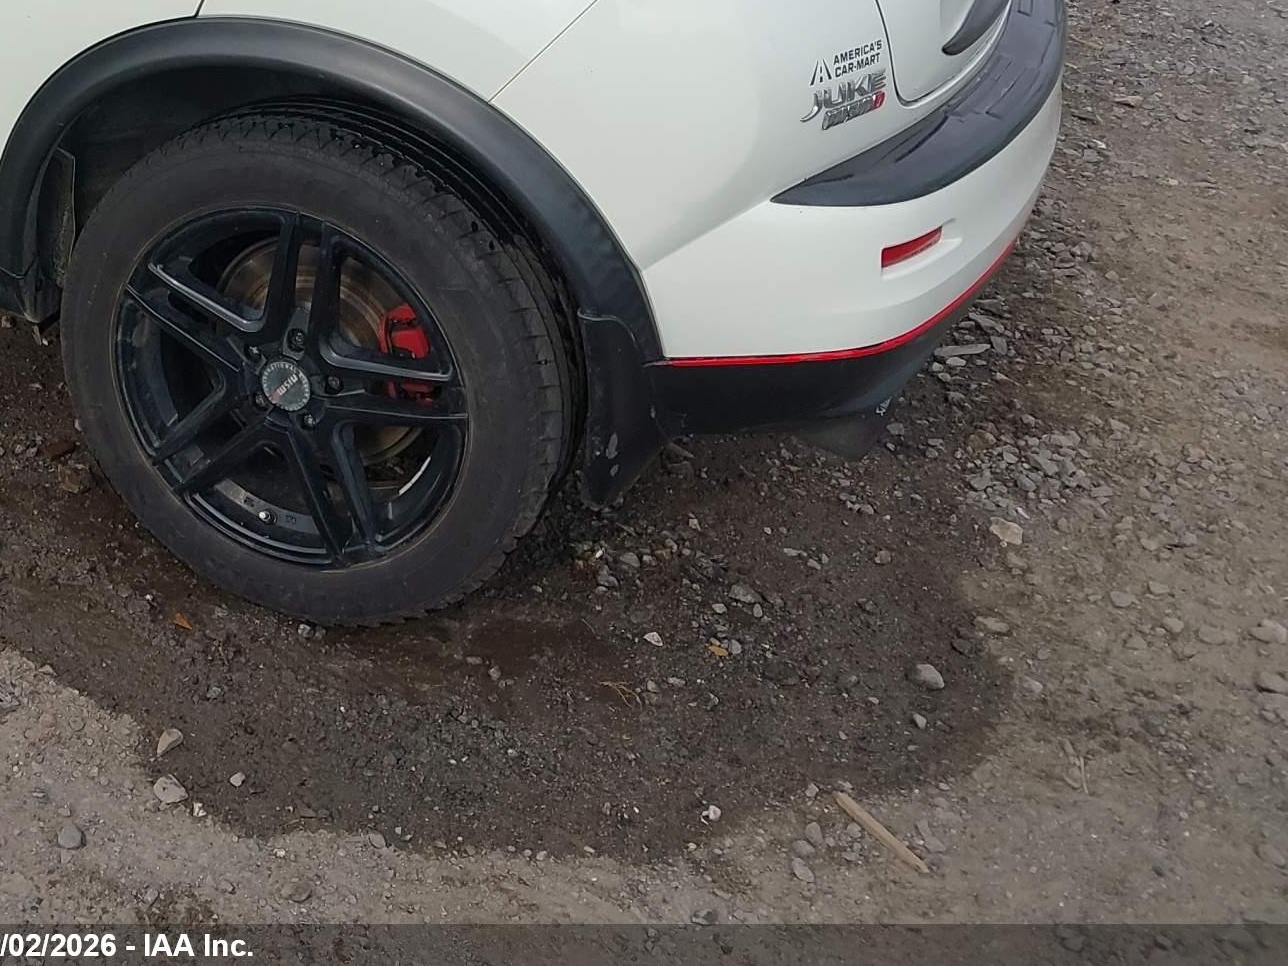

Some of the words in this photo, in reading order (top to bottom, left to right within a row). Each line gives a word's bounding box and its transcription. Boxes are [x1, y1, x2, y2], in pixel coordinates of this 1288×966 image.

[833, 39, 883, 66] AMERICA'S
[835, 52, 881, 79] CAR-MART
[800, 68, 887, 123] JUKE
